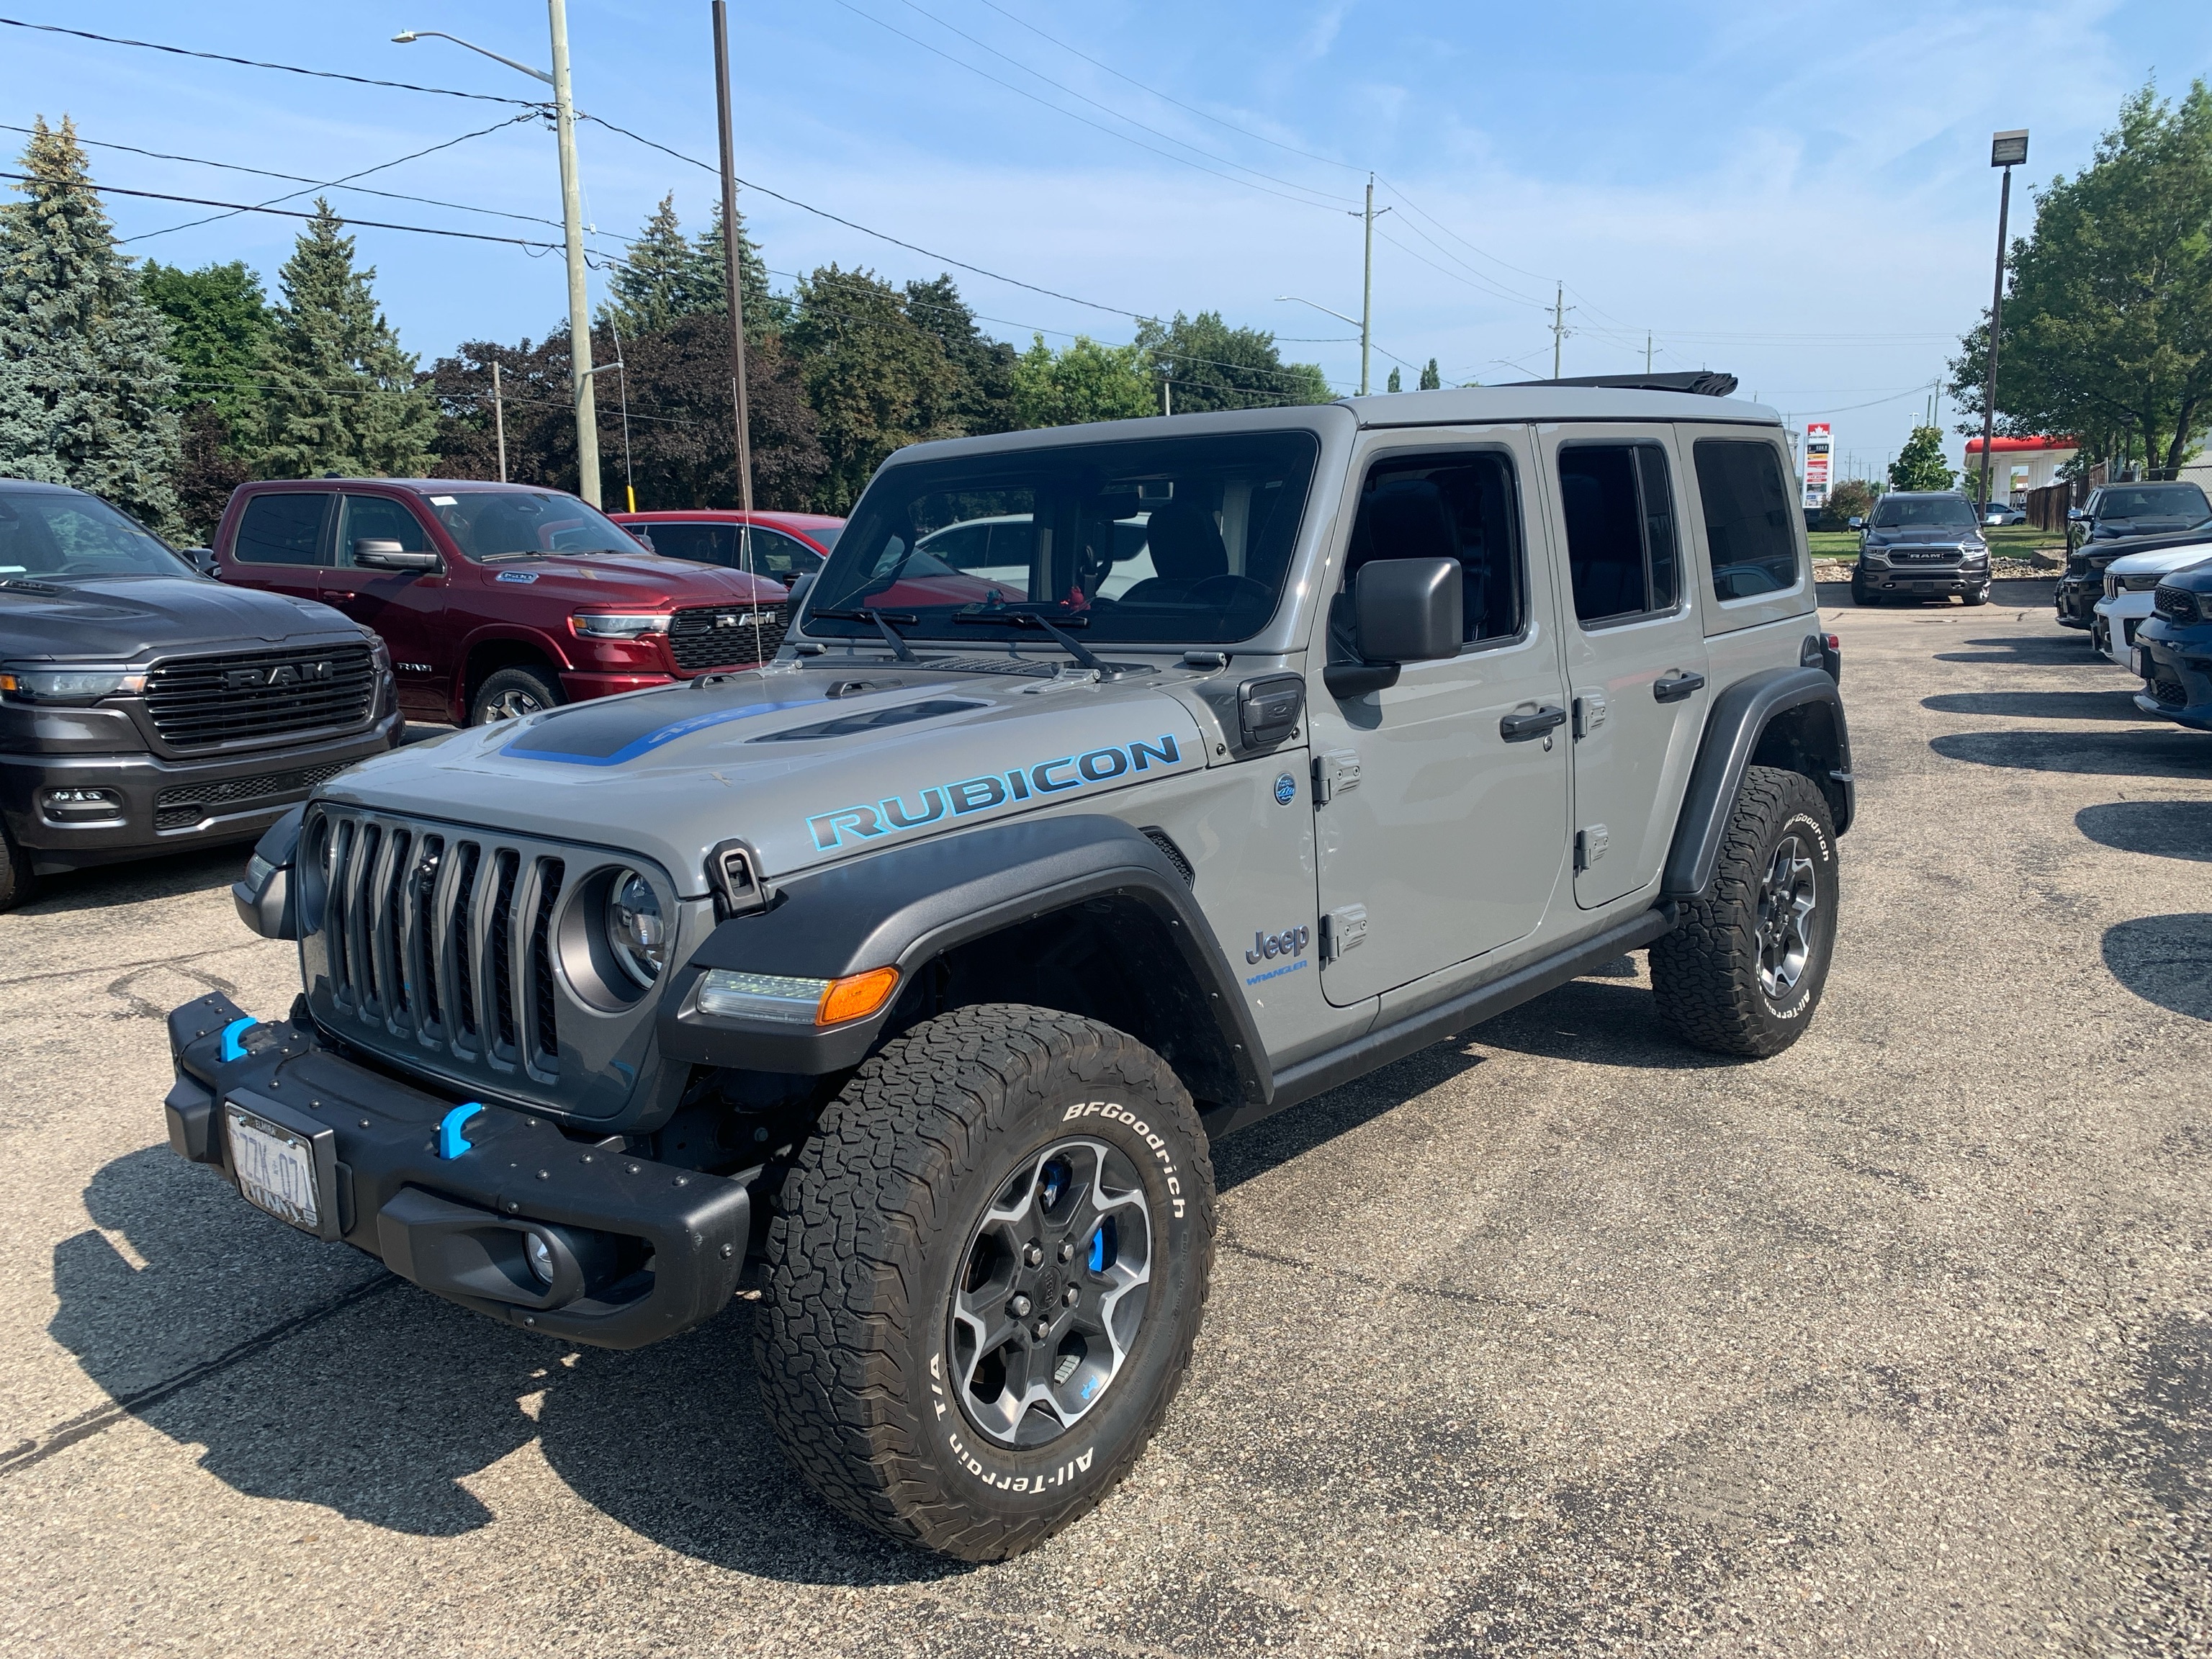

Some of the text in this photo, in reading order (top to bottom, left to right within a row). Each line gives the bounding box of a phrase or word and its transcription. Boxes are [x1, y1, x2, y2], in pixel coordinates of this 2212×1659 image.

[715, 611, 776, 628] RAM
[227, 661, 333, 688] RAM
[397, 662, 432, 672] RAM
[806, 734, 1182, 851] RUBICON
[1783, 813, 1829, 861] BFGoodrich
[1246, 925, 1310, 965] Jeep
[1246, 960, 1308, 986] WRANGLER
[1764, 989, 1810, 1019] All-Terrain
[255, 1120, 276, 1136] ELMIRA
[1062, 1102, 1185, 1218] BFGoodrich
[930, 1353, 946, 1421] T/A
[949, 1433, 1094, 1494] All-Terrain
